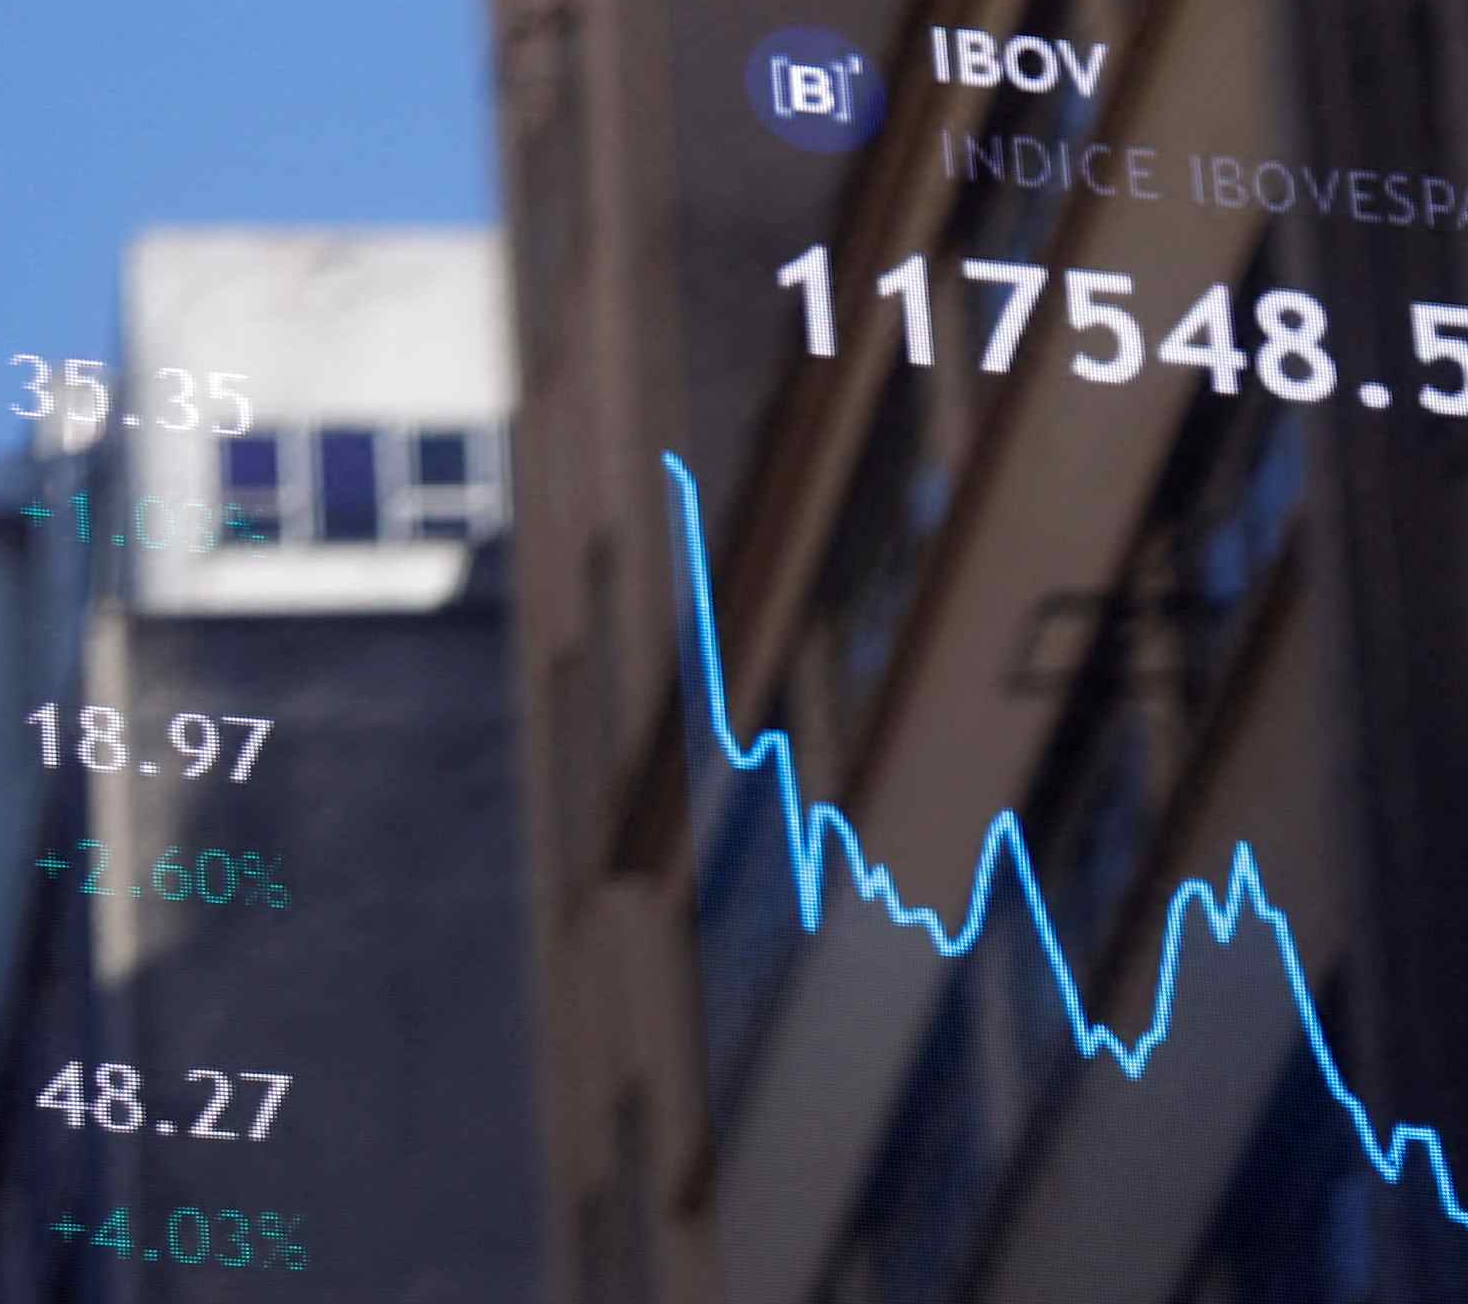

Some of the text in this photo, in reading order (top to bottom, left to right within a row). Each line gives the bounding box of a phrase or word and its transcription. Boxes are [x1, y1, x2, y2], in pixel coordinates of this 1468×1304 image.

[932, 25, 1110, 98] IBOV
[941, 128, 1160, 200] INDICE
[7, 352, 257, 439] 35.35
[24, 701, 276, 785] 18.97
[35, 837, 292, 910] +2.60%
[35, 1059, 295, 1142] 48.27
[49, 1205, 309, 1272] +4.03%
